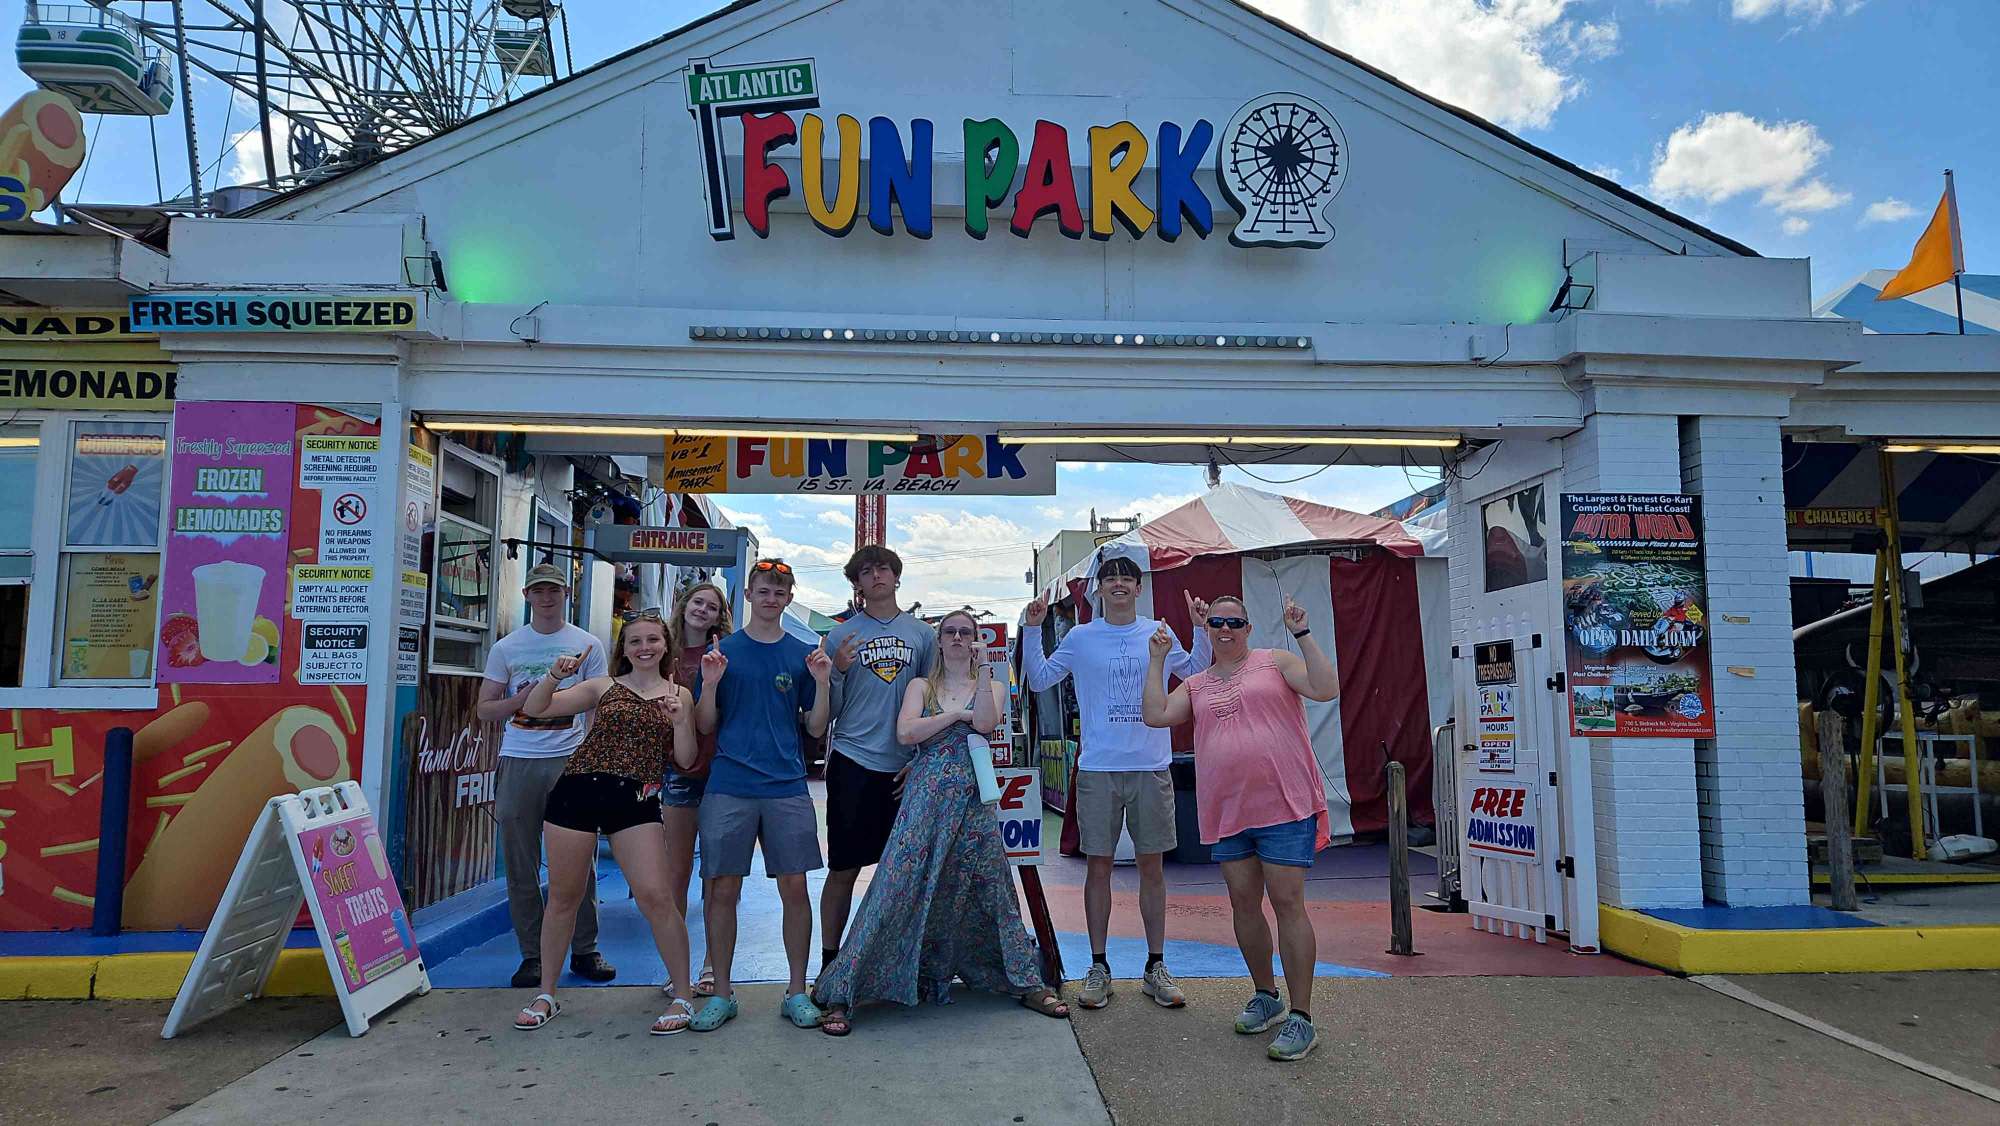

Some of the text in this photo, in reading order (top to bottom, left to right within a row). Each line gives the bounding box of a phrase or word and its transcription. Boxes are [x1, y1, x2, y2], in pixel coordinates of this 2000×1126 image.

[700, 68, 803, 101] ATLANTIC
[741, 112, 1215, 241] FUN PARK
[132, 301, 414, 329] FRESH SQUEEZED
[0, 369, 177, 400] EMONADE
[176, 436, 293, 460] Freshly Squeezed
[306, 440, 378, 450] SECURITY NOTICE
[311, 455, 334, 463] METAL
[671, 449, 689, 461] VB
[736, 434, 1027, 479] FUN PARK
[304, 464, 378, 473] SCREENING REQUIRED
[666, 460, 724, 480] Amusement
[197, 468, 263, 491] FROZEN
[678, 475, 714, 490] PARK
[797, 479, 812, 491] 15
[825, 479, 852, 491] ST.
[893, 479, 961, 491] BEACH
[1567, 495, 1693, 504] The Largest & Fastest Go-Kart
[1572, 504, 1611, 513] Complex
[1613, 504, 1626, 512] On
[1644, 505, 1663, 513] East
[1664, 505, 1690, 513] Coast!
[176, 508, 282, 532] LEMONADES
[1803, 508, 1873, 525] CHALLENGE
[325, 529, 372, 537] NO FIREARMS
[1568, 513, 1695, 540] MOTOR WORLD
[632, 531, 705, 550] ENTRANCE
[298, 569, 371, 579] SECURITY NOTICE
[298, 585, 323, 593] EMPTY
[340, 585, 369, 593] POCKET
[300, 595, 366, 603] CONTENTS BEFORE
[295, 605, 331, 613] ENTERING
[1628, 610, 1652, 618] Revved
[309, 627, 363, 636] SECURITY
[1579, 629, 1697, 647] OPEN DAILY 10AM
[315, 639, 355, 648] NOTICE
[874, 637, 897, 647] STATE
[311, 651, 358, 659] ALL BAGS
[860, 646, 912, 665] CHAMPION
[1488, 645, 1497, 662] NO
[305, 662, 363, 670] SUBJECT TO
[1478, 662, 1513, 681] TRESPASSING
[306, 672, 361, 680] INSPECTION
[1483, 691, 1504, 702] FUN
[1480, 703, 1509, 716] PARK
[1486, 722, 1509, 732] HOURS
[418, 716, 484, 774] Hand Cut
[456, 771, 496, 808] FRI
[1471, 787, 1526, 818] FREE
[1467, 818, 1536, 850] ADMISSION
[322, 862, 360, 897] SWEET
[345, 886, 389, 926] TREATS
